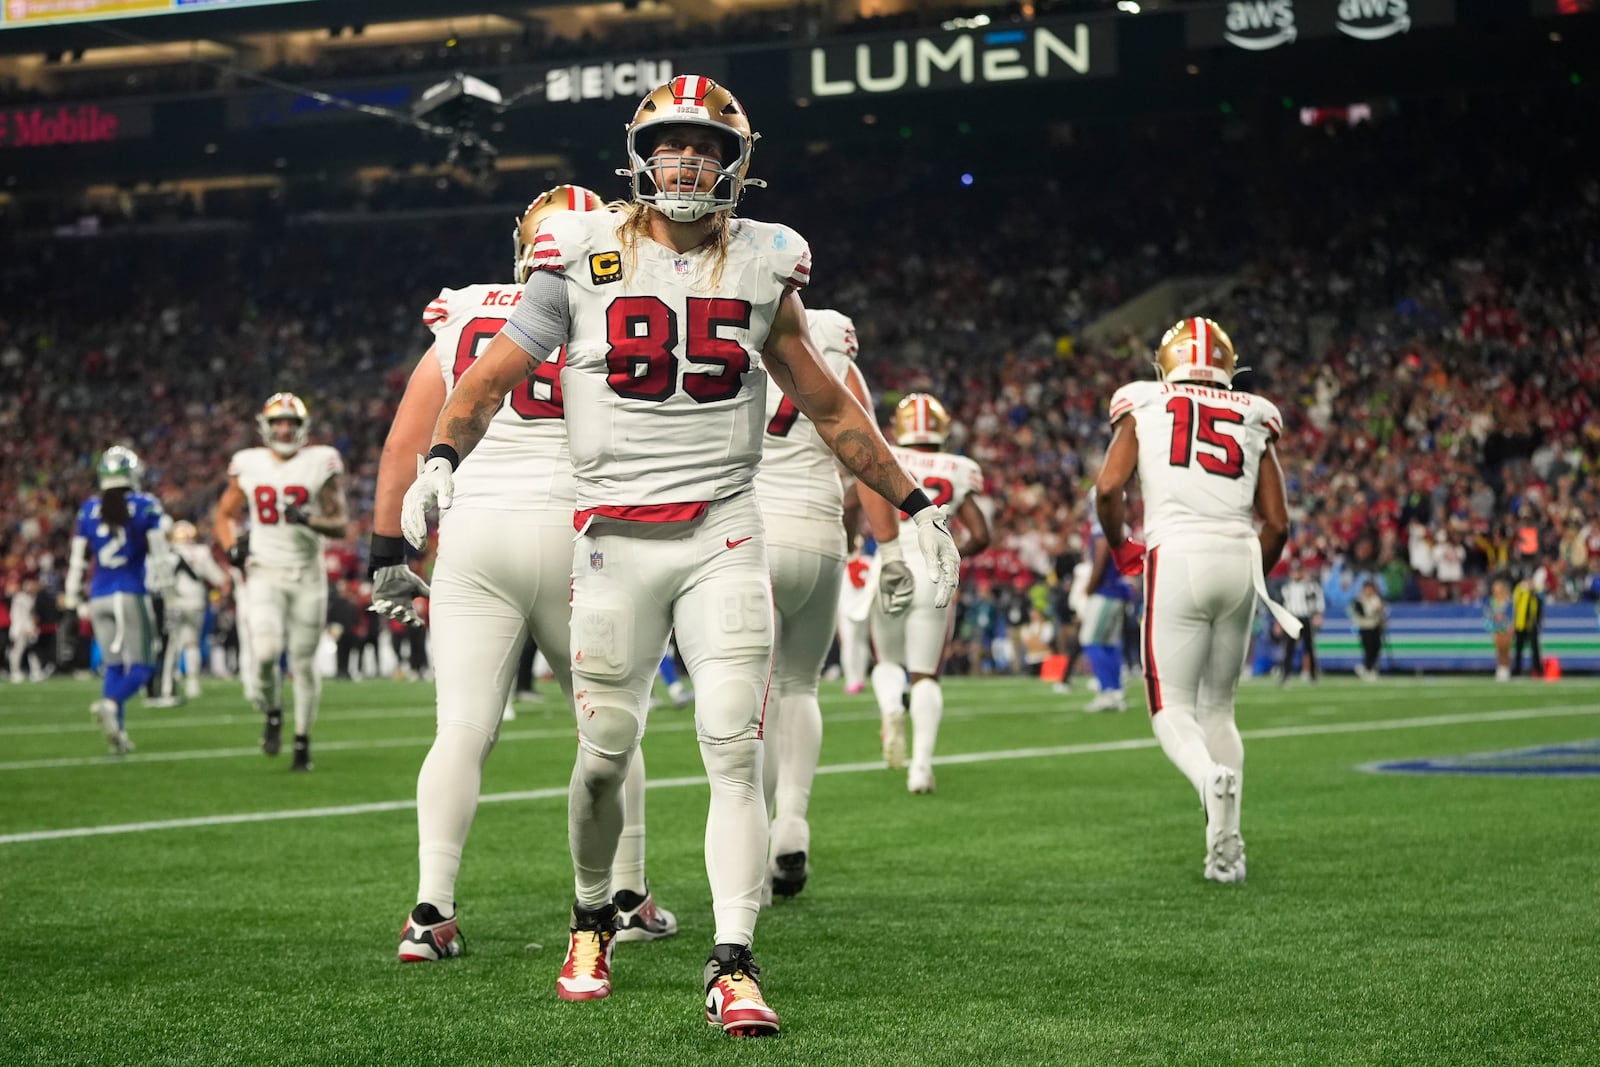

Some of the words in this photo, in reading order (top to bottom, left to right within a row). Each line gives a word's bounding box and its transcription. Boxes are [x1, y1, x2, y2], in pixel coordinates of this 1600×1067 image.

[1226, 0, 1294, 31] aws
[1338, 0, 1408, 20] aws
[811, 23, 1090, 96] LUMEN
[14, 104, 118, 147] Mobile
[592, 252, 619, 276] C
[605, 296, 752, 404] 85
[1166, 396, 1245, 479] 15
[96, 523, 128, 569] 2
[720, 591, 767, 634] 85
